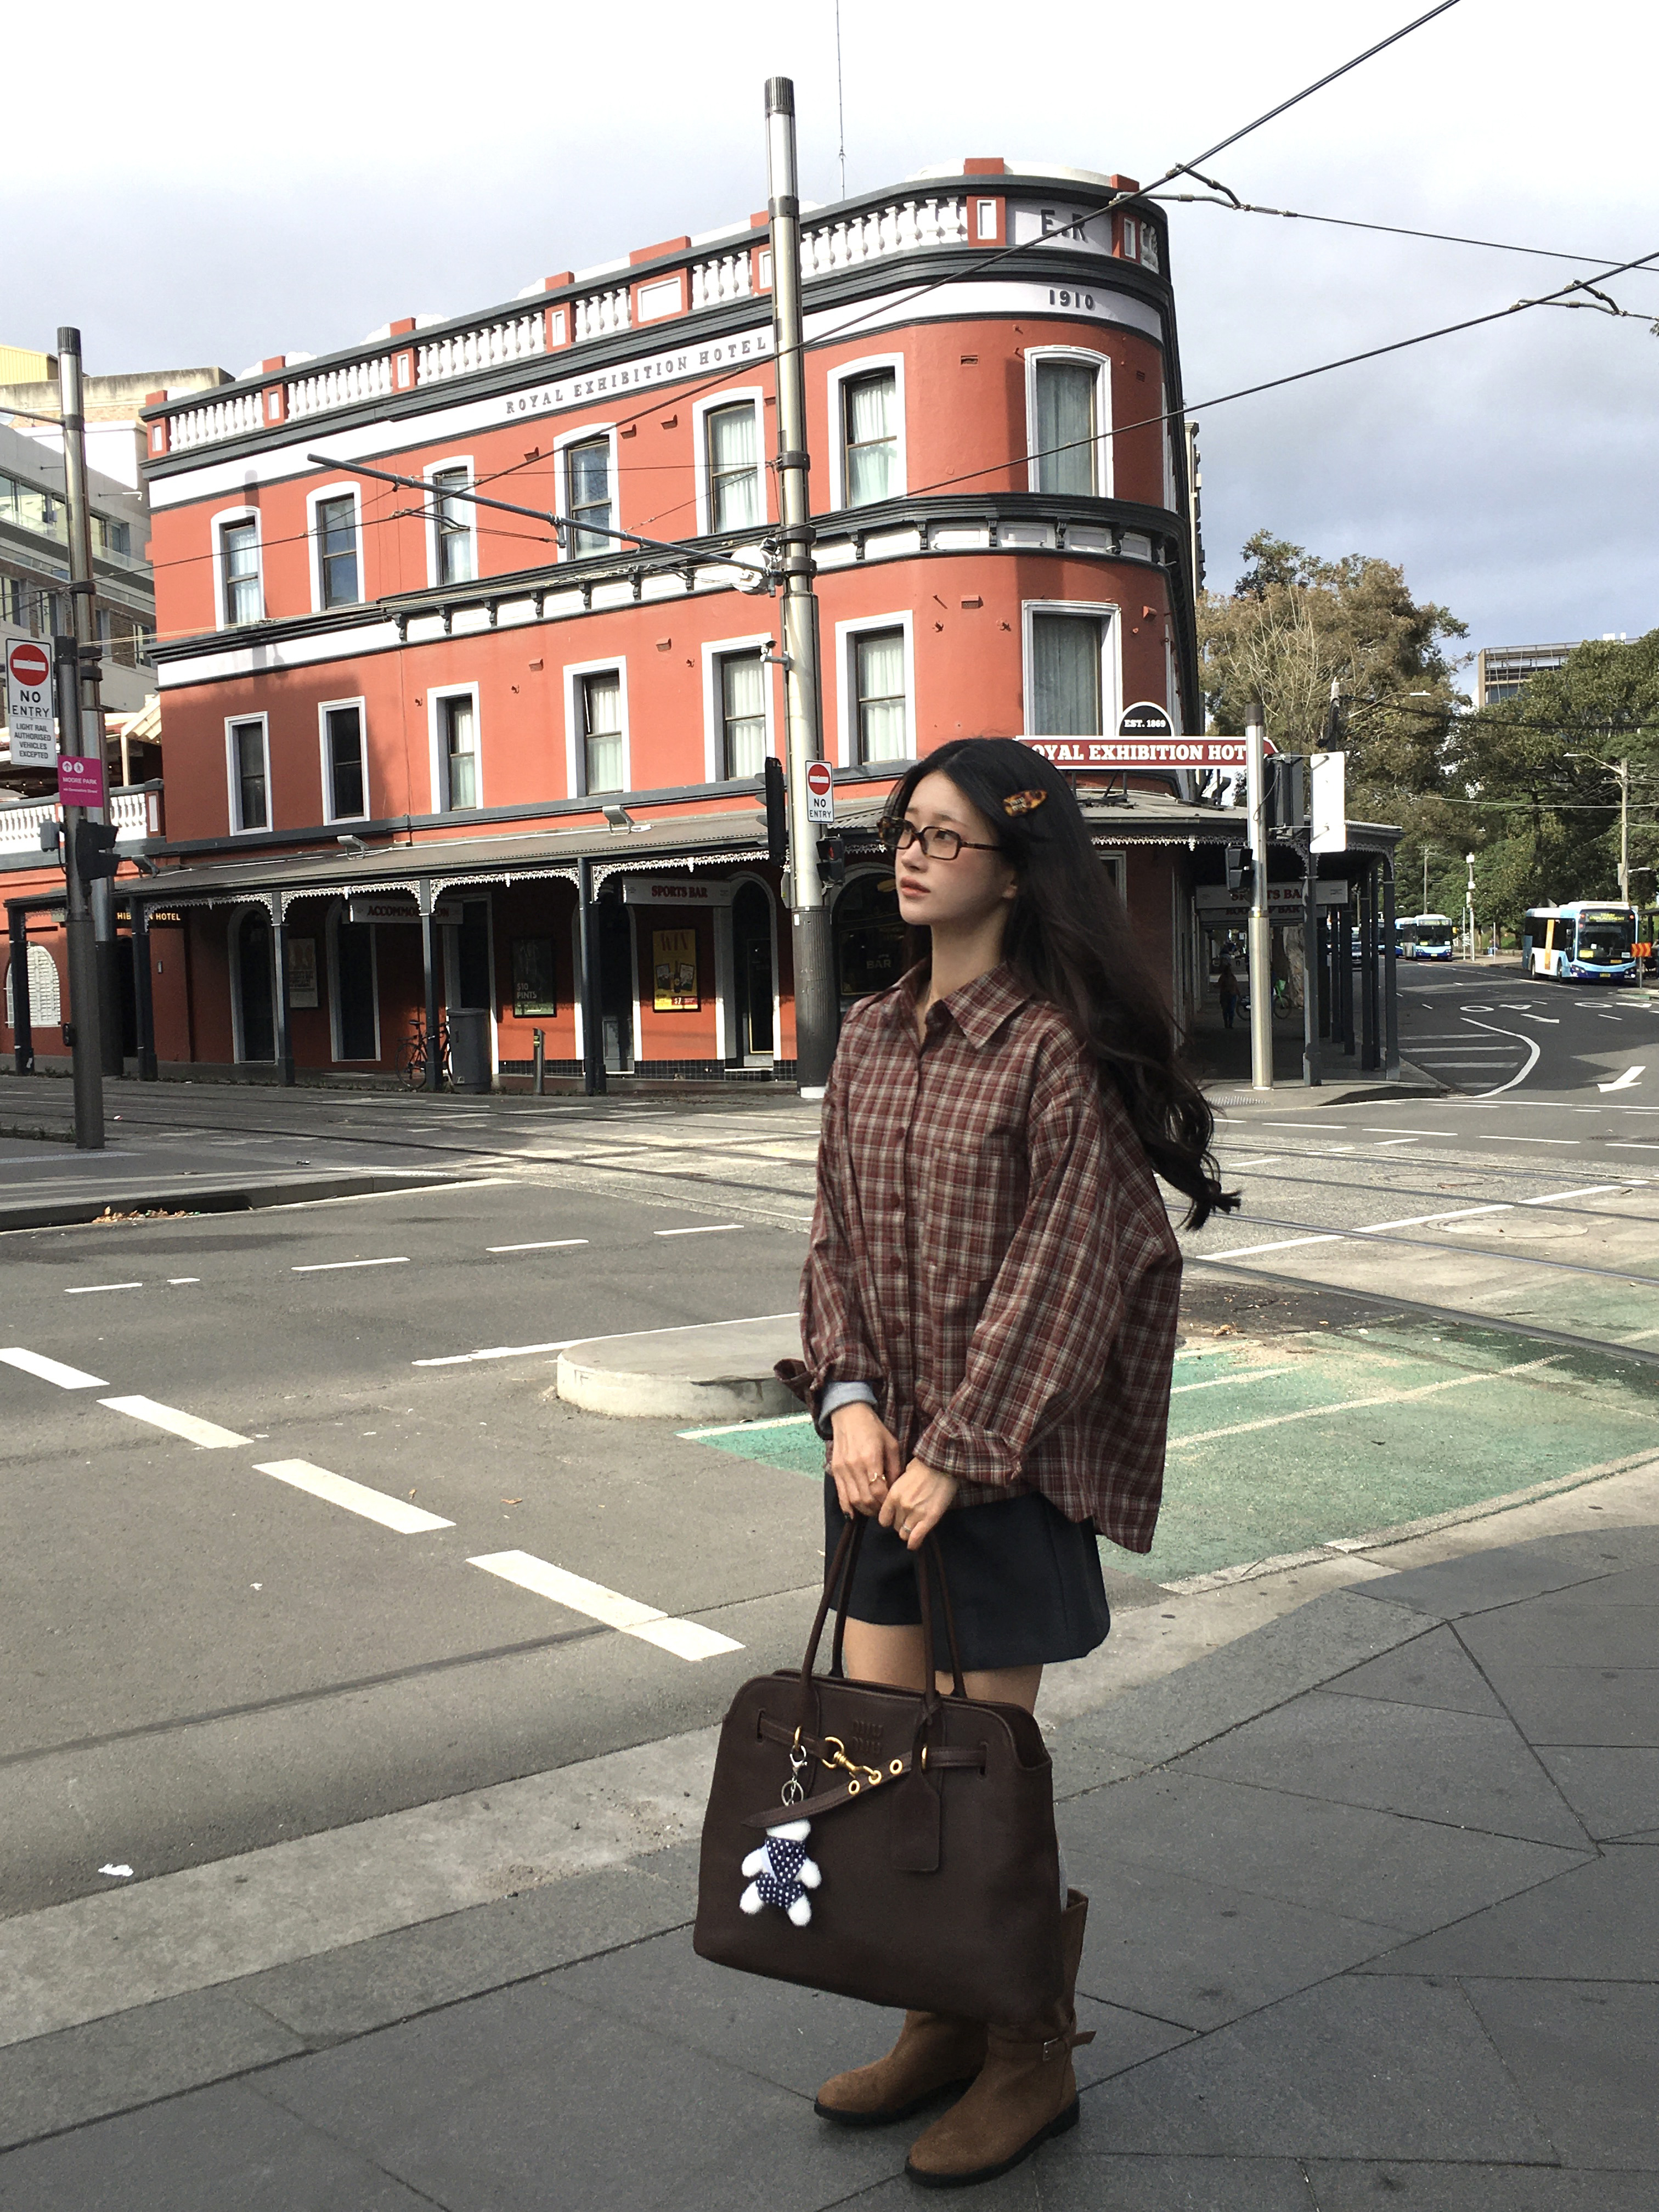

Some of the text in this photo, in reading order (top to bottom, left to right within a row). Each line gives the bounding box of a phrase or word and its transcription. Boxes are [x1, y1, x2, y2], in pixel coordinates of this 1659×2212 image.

[1049, 289, 1093, 310] 1910
[506, 336, 766, 414] ROYAL EXHIBITION HOTEL
[20, 689, 41, 703] NO
[12, 704, 50, 718] ENTRY
[16, 723, 48, 732] LIGHT RAIL
[1124, 719, 1166, 728] EST. 1869
[14, 732, 52, 741] AUTHORISED
[19, 742, 47, 750] VEHICLES
[19, 750, 48, 759] EXCEPTED
[1031, 744, 1246, 761] OYAL EXHIBITION HOT
[814, 798, 826, 808] NO
[809, 810, 832, 818] ENTRY
[651, 885, 687, 897] SPORTS
[688, 887, 708, 898] BAR
[1284, 889, 1302, 899] BA
[866, 960, 891, 969] BAR
